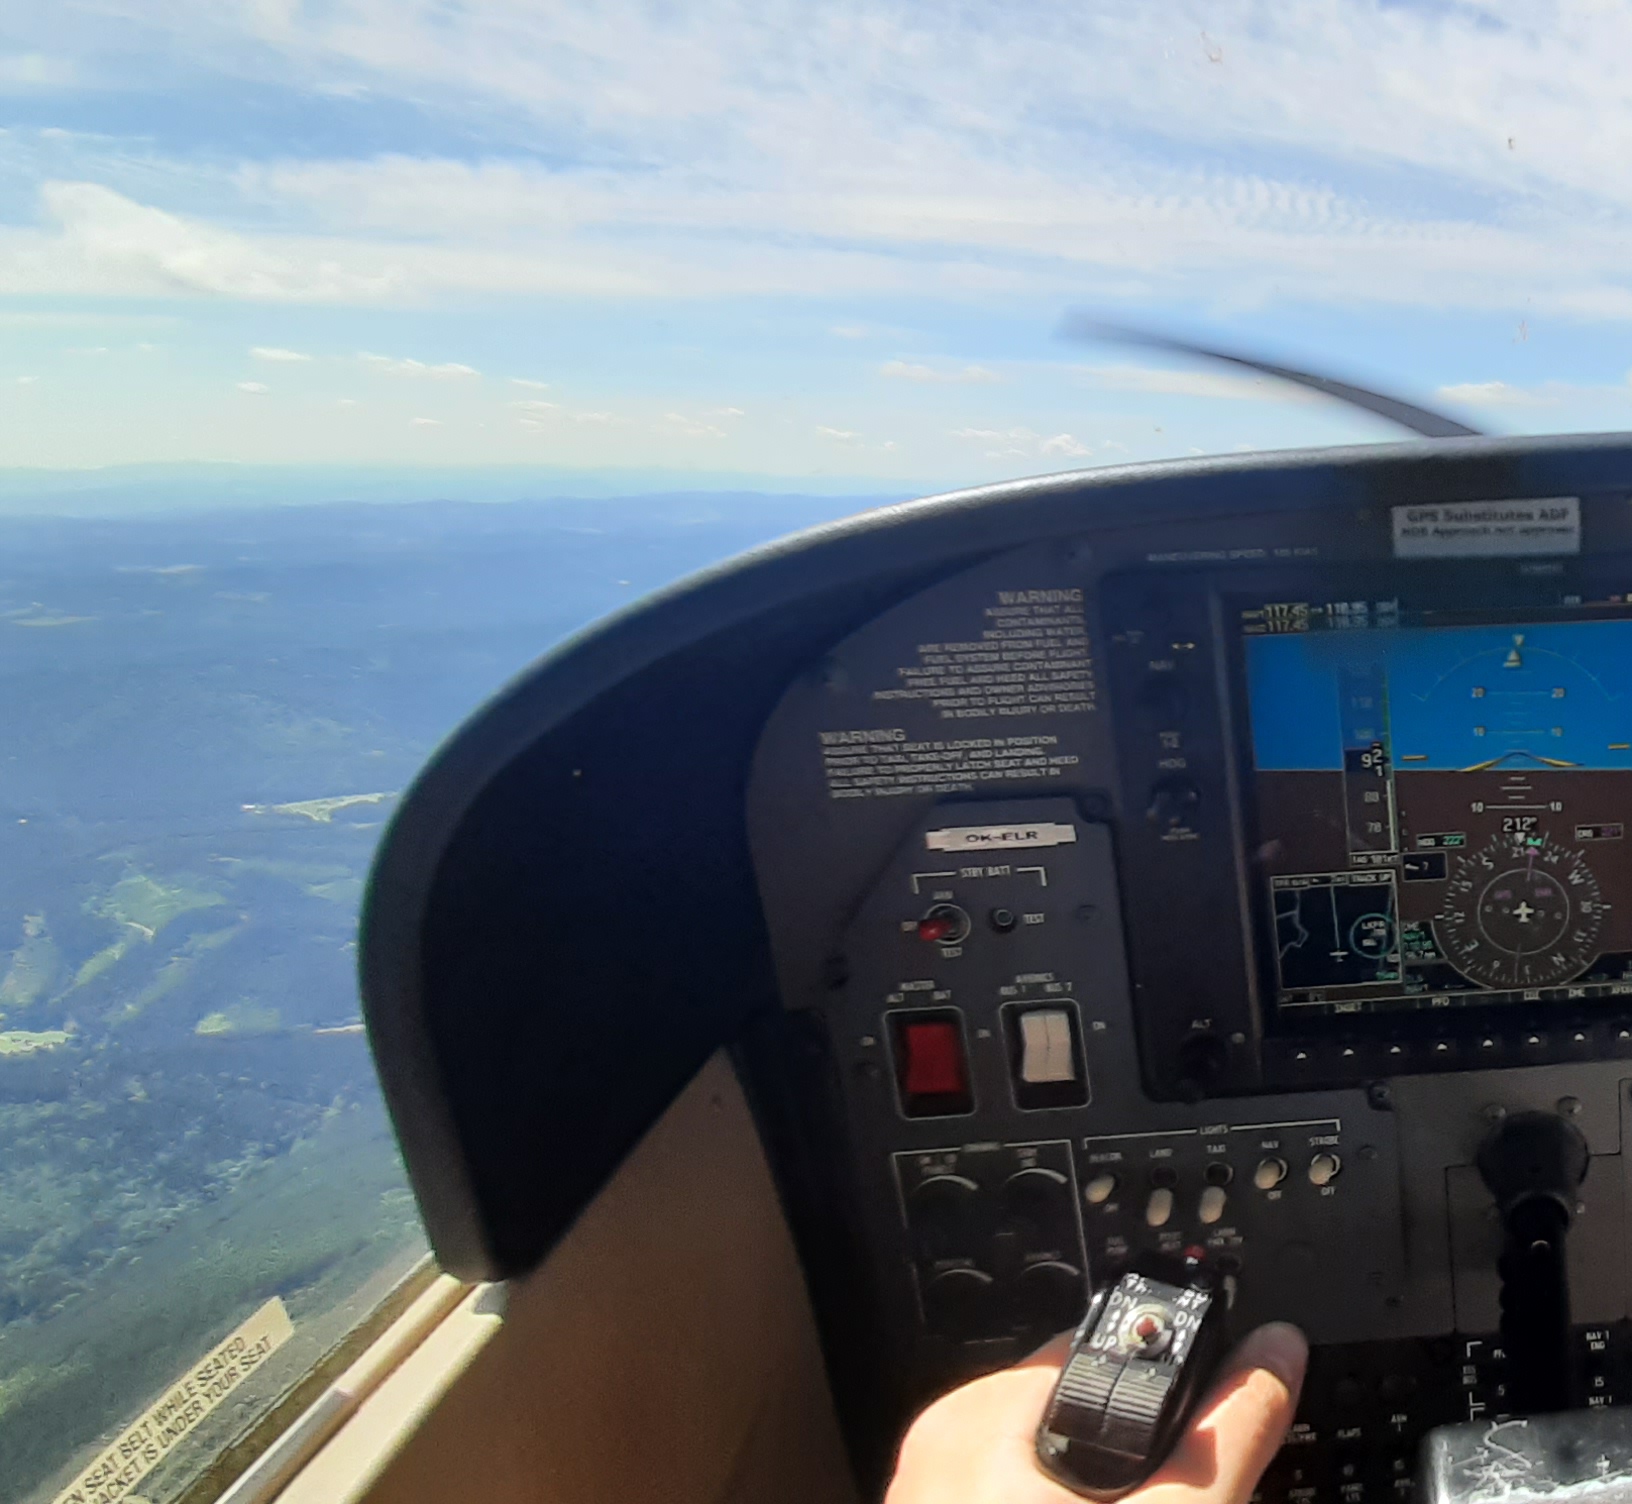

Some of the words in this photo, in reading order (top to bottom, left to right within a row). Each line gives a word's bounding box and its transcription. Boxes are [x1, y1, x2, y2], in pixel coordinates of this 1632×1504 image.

[1407, 508, 1438, 522] GPS
[1539, 507, 1570, 520] ADF
[998, 588, 1083, 604] WARNING
[1029, 671, 1049, 681] ALL
[988, 694, 1025, 706] FLIGHT
[1028, 693, 1052, 703] CAN
[1054, 690, 1096, 702] RESULT
[1041, 702, 1056, 712] OR
[819, 728, 907, 745] WARNING
[947, 738, 992, 750] LOCKED
[1007, 735, 1058, 746] POSITION
[969, 749, 993, 759] AND
[957, 759, 992, 770] LATCH
[994, 758, 1022, 768] SEAT
[1024, 756, 1048, 767] AND
[1050, 754, 1080, 765] HEED
[980, 769, 1004, 780] CAN
[1006, 766, 1048, 778] RESULT
[965, 830, 1040, 844] OK-ELR
[960, 867, 984, 878] STBY
[987, 864, 1012, 876] BATT
[1023, 912, 1045, 925] TEST
[1191, 1018, 1213, 1030] ALT
[1200, 1125, 1229, 1136] LIGHTS
[1206, 1144, 1227, 1155] TAXI
[1261, 1140, 1280, 1150] NAV
[1309, 1134, 1341, 1148] STROBE
[1173, 1310, 1204, 1331] DN
[1092, 1332, 1118, 1351] UP
[159, 1400, 204, 1451] UNDER
[203, 1367, 240, 1406] YOUR
[240, 1334, 273, 1373] SEAT
[85, 1453, 120, 1494] SEAT
[119, 1417, 152, 1458] BELT
[153, 1381, 197, 1428] WHILE
[197, 1336, 246, 1388] SEATED
